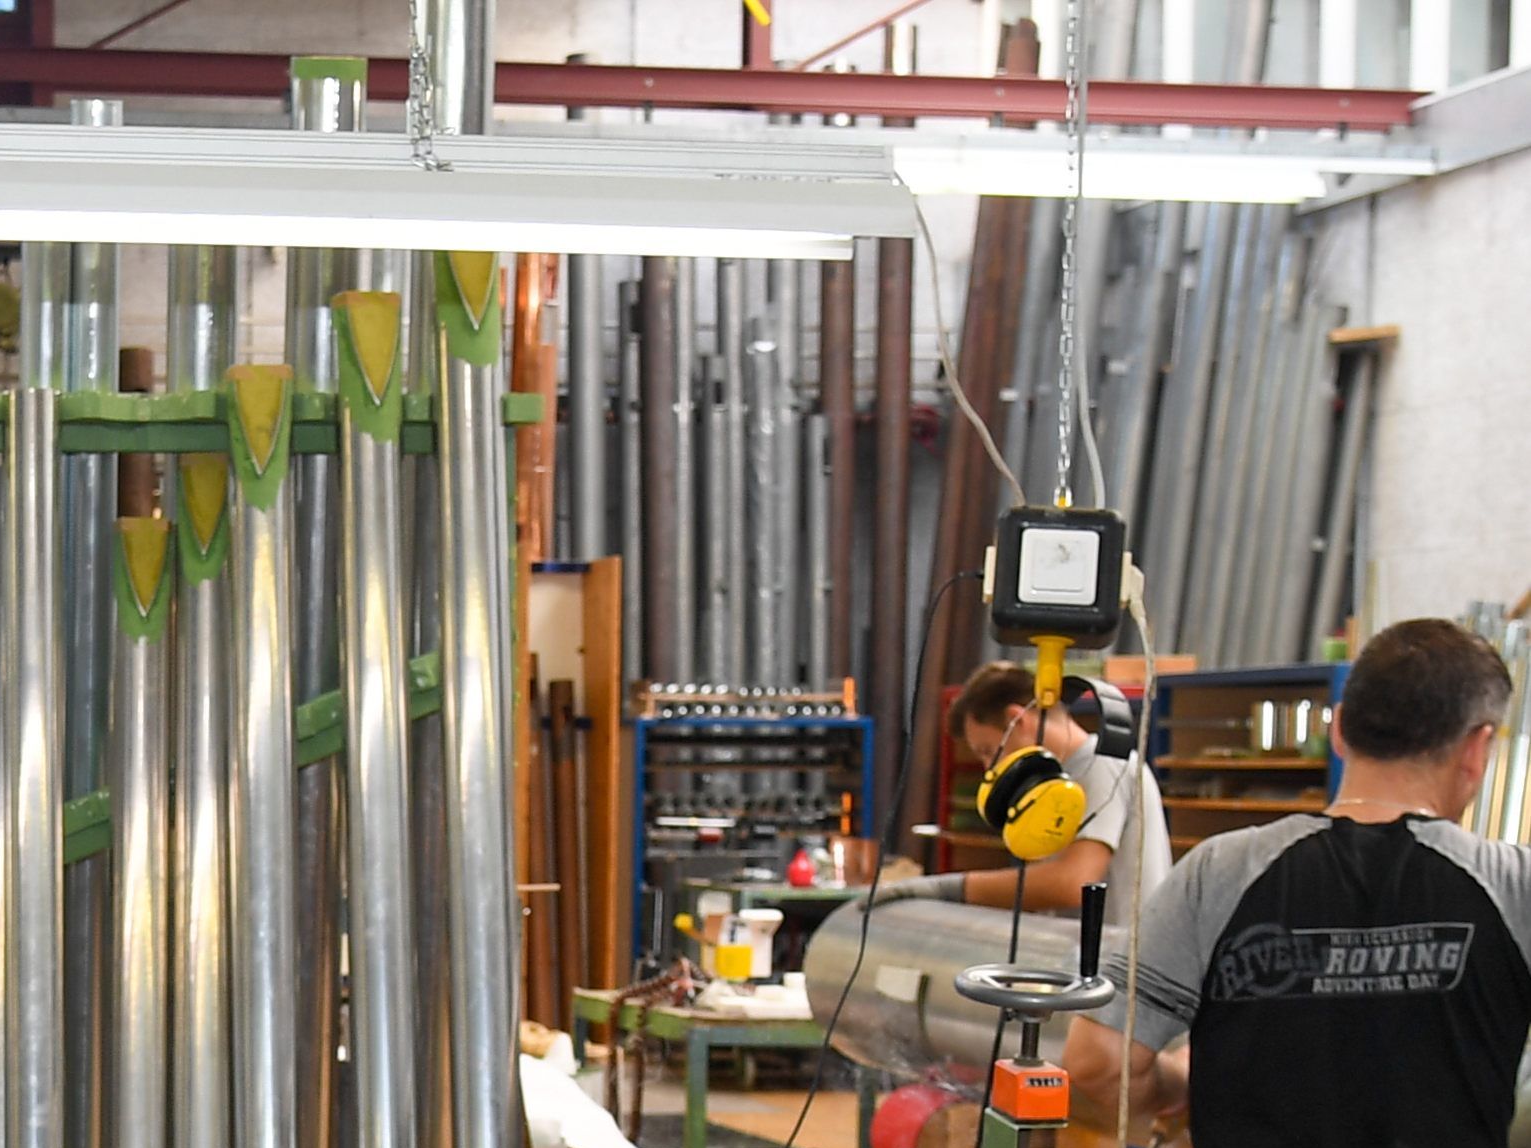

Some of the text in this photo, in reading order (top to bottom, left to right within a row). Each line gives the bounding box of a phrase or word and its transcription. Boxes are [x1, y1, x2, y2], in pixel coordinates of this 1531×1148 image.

[1325, 942, 1461, 975] ROVING
[1312, 973, 1440, 994] ADVENTRE DAY
